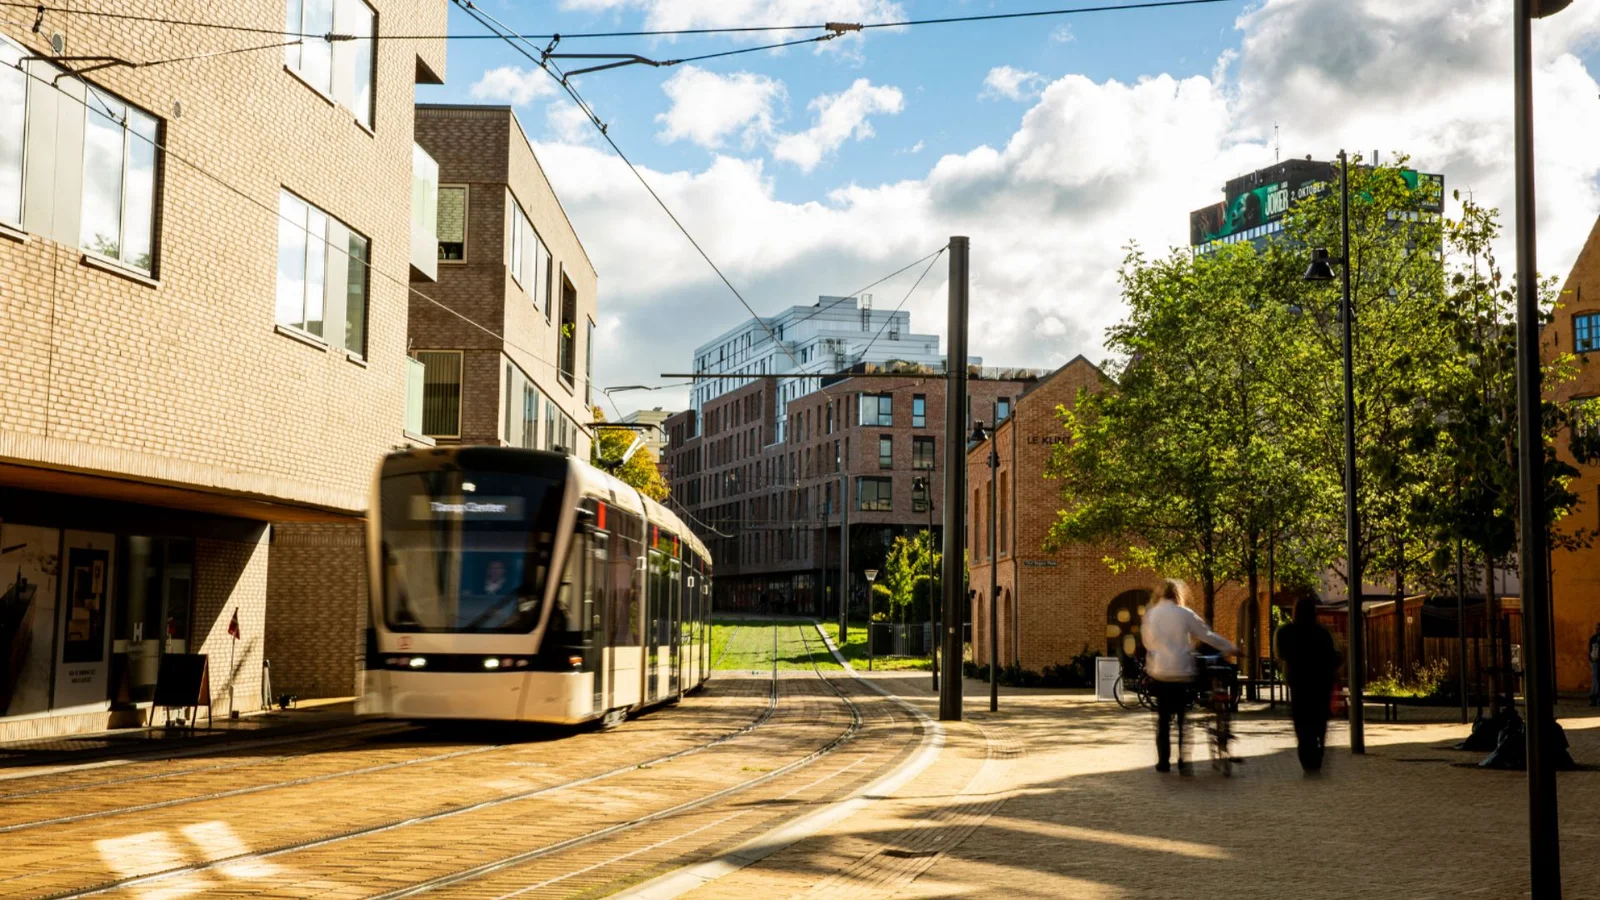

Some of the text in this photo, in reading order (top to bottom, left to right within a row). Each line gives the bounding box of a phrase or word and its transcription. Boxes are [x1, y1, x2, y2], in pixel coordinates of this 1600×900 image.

[1265, 188, 1289, 216] JOKER
[1027, 436, 1038, 445] LE
[133, 622, 143, 642] H
